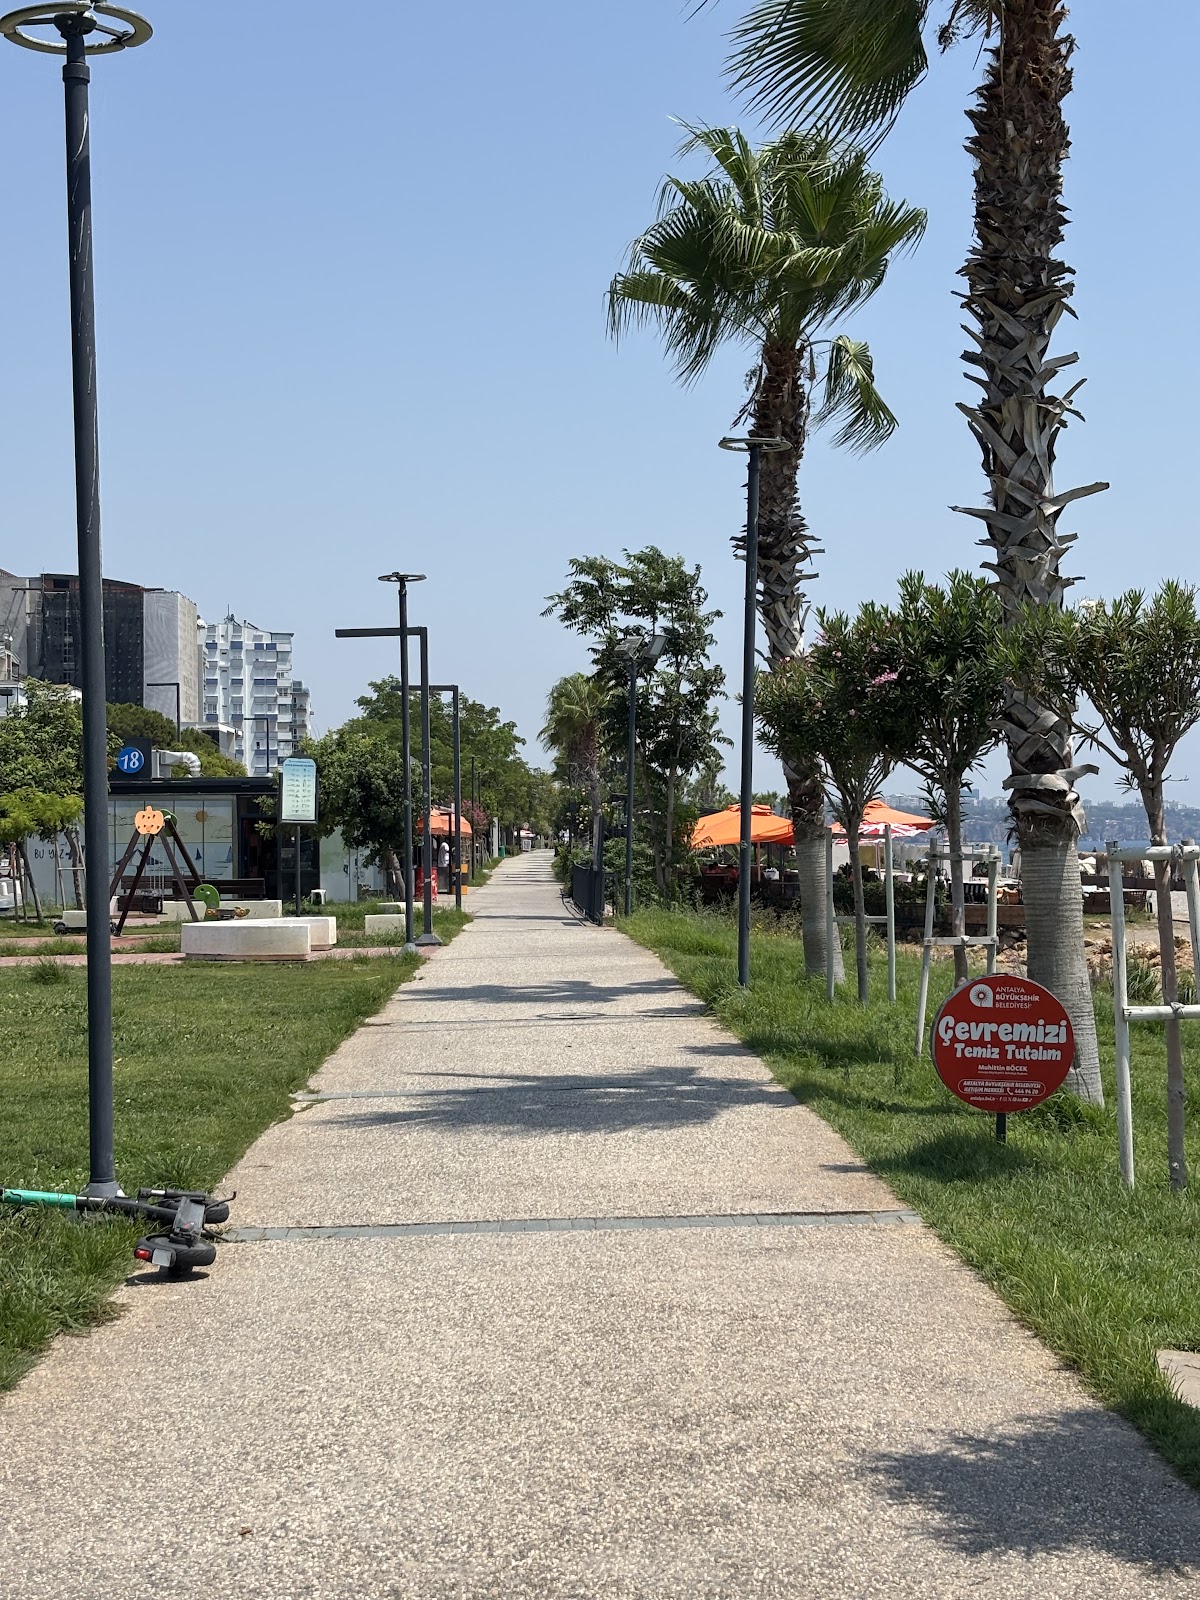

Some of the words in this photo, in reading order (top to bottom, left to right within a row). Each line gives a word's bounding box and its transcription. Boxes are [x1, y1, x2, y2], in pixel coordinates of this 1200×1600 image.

[120, 751, 139, 769] 18
[34, 848, 44, 859] BU
[48, 848, 64, 859] YZ
[995, 993, 1040, 1002] BÜYÜKŞEHİR
[938, 1015, 1067, 1046] Çevremizi
[954, 1042, 1000, 1059] Temiz
[1004, 1044, 1061, 1061] Tutalım
[1006, 1064, 1028, 1072] BÖCEK
